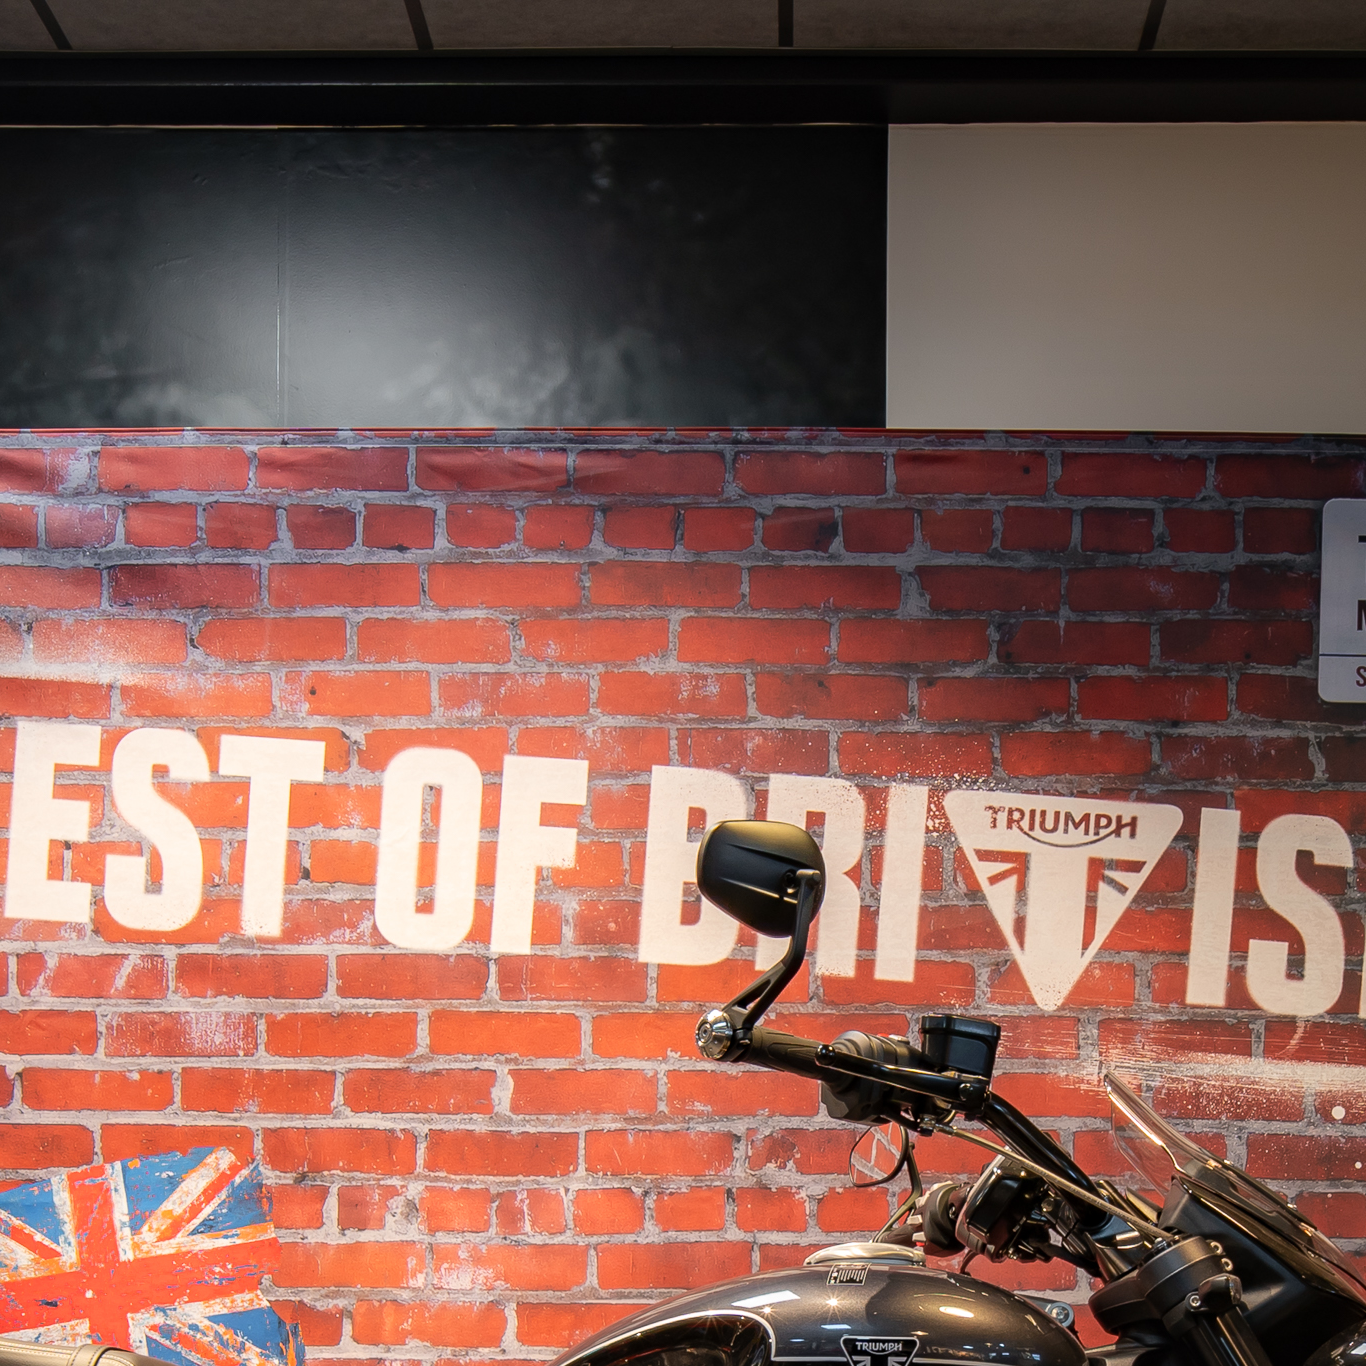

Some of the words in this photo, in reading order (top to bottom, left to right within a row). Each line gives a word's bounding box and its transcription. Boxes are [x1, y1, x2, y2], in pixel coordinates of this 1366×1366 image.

[985, 804, 1138, 843] TRIUMPH
[374, 746, 590, 956] OF
[855, 1342, 903, 1353] TRIUMPH
